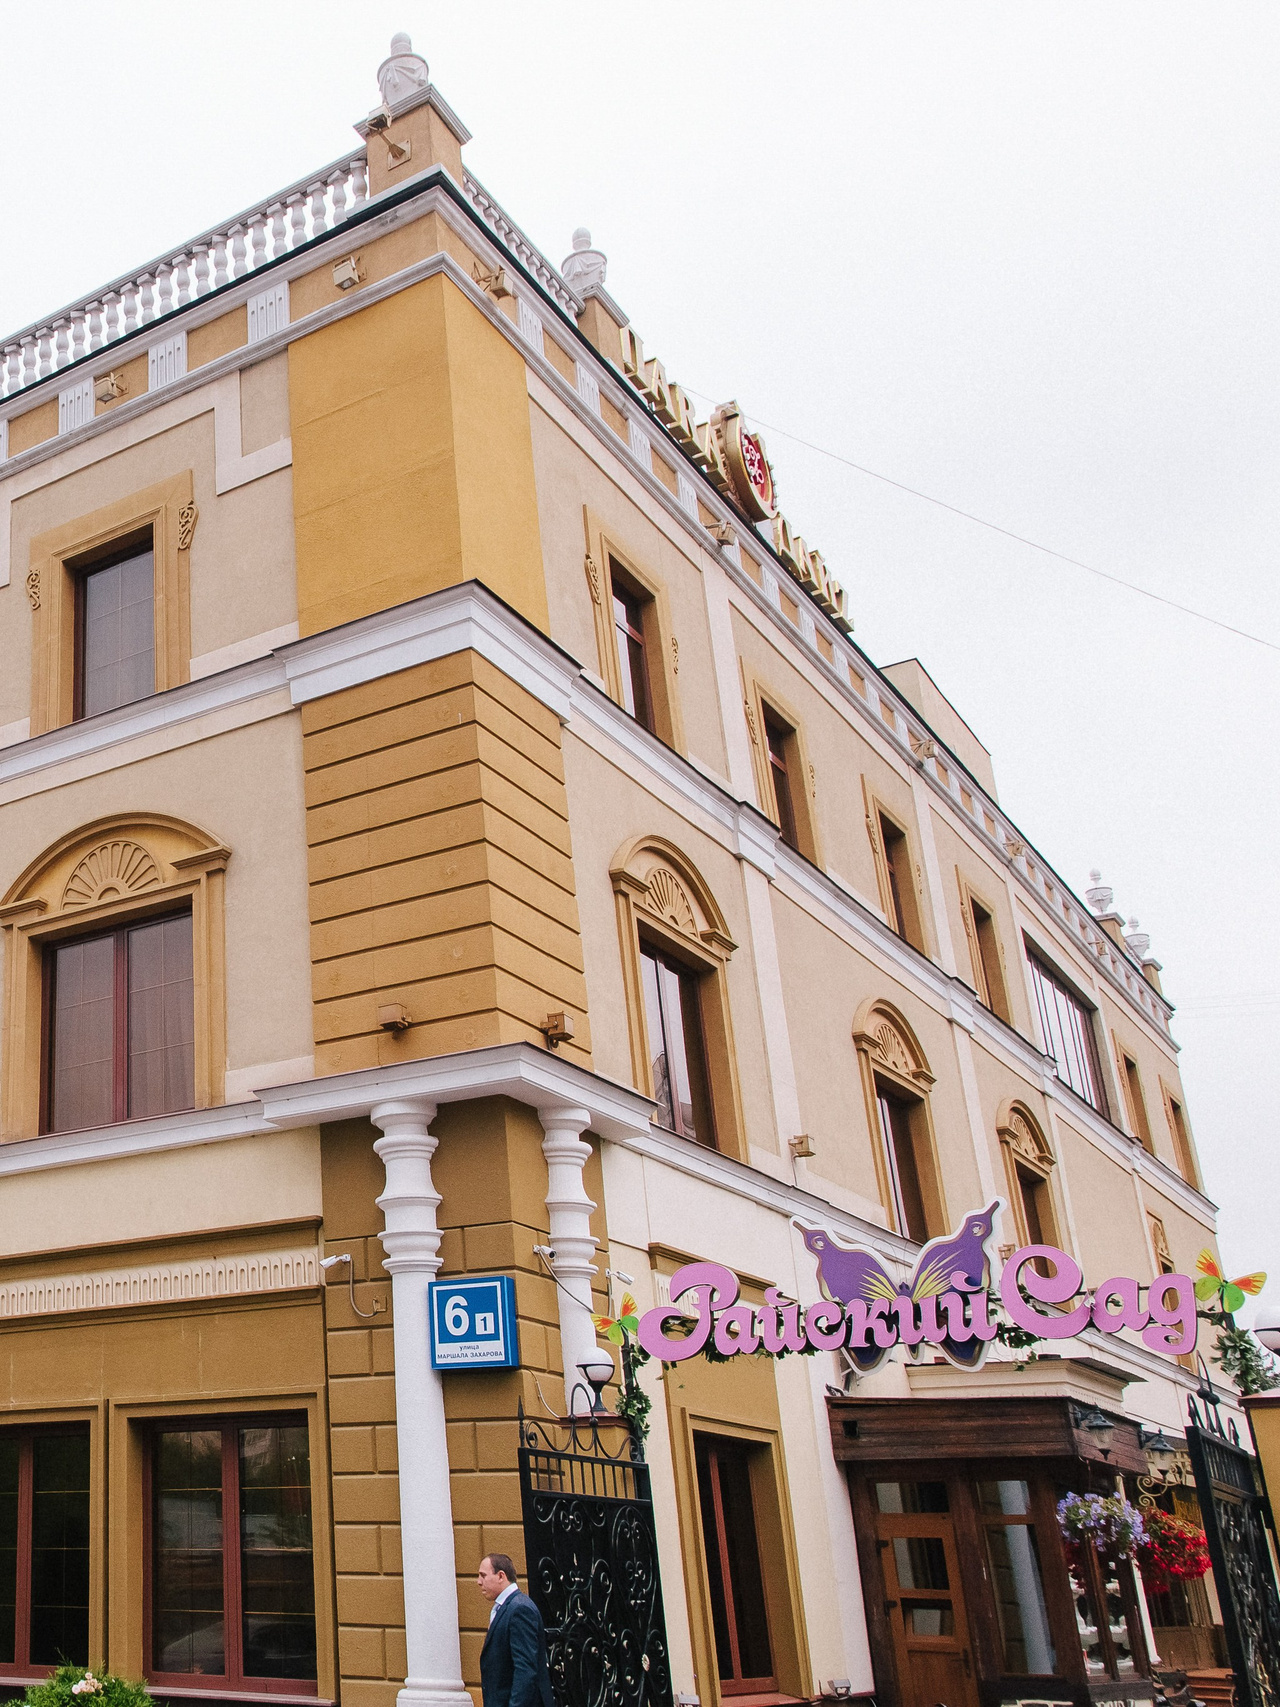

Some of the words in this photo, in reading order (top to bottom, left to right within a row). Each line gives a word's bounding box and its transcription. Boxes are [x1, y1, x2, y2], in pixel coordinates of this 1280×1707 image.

[444, 1295, 470, 1336] 6
[637, 1262, 998, 1362] Райский
[1000, 1245, 1199, 1355] Сад
